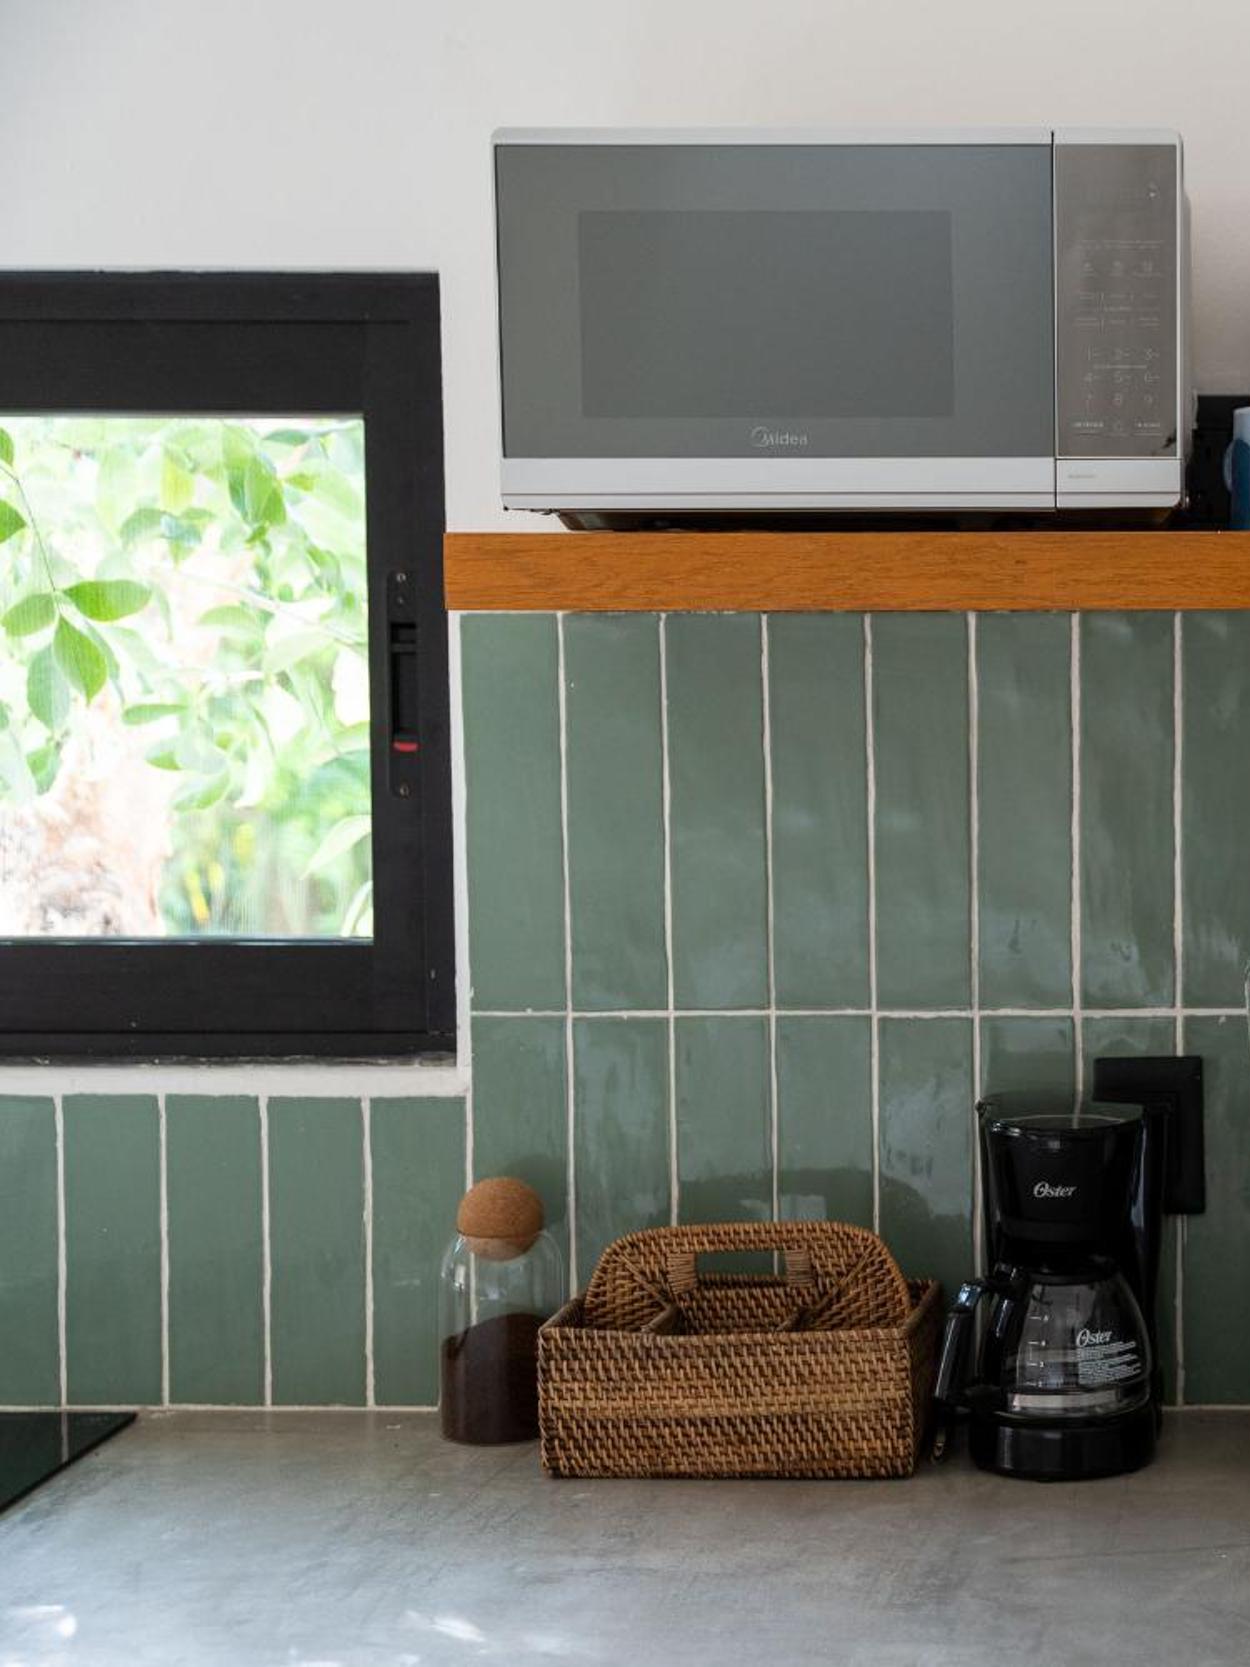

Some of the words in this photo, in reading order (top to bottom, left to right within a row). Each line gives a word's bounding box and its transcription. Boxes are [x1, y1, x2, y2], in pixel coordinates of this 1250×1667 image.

[752, 427, 808, 447] Midea
[1033, 1180, 1078, 1197] Oster
[1076, 1329, 1113, 1348] Oster
